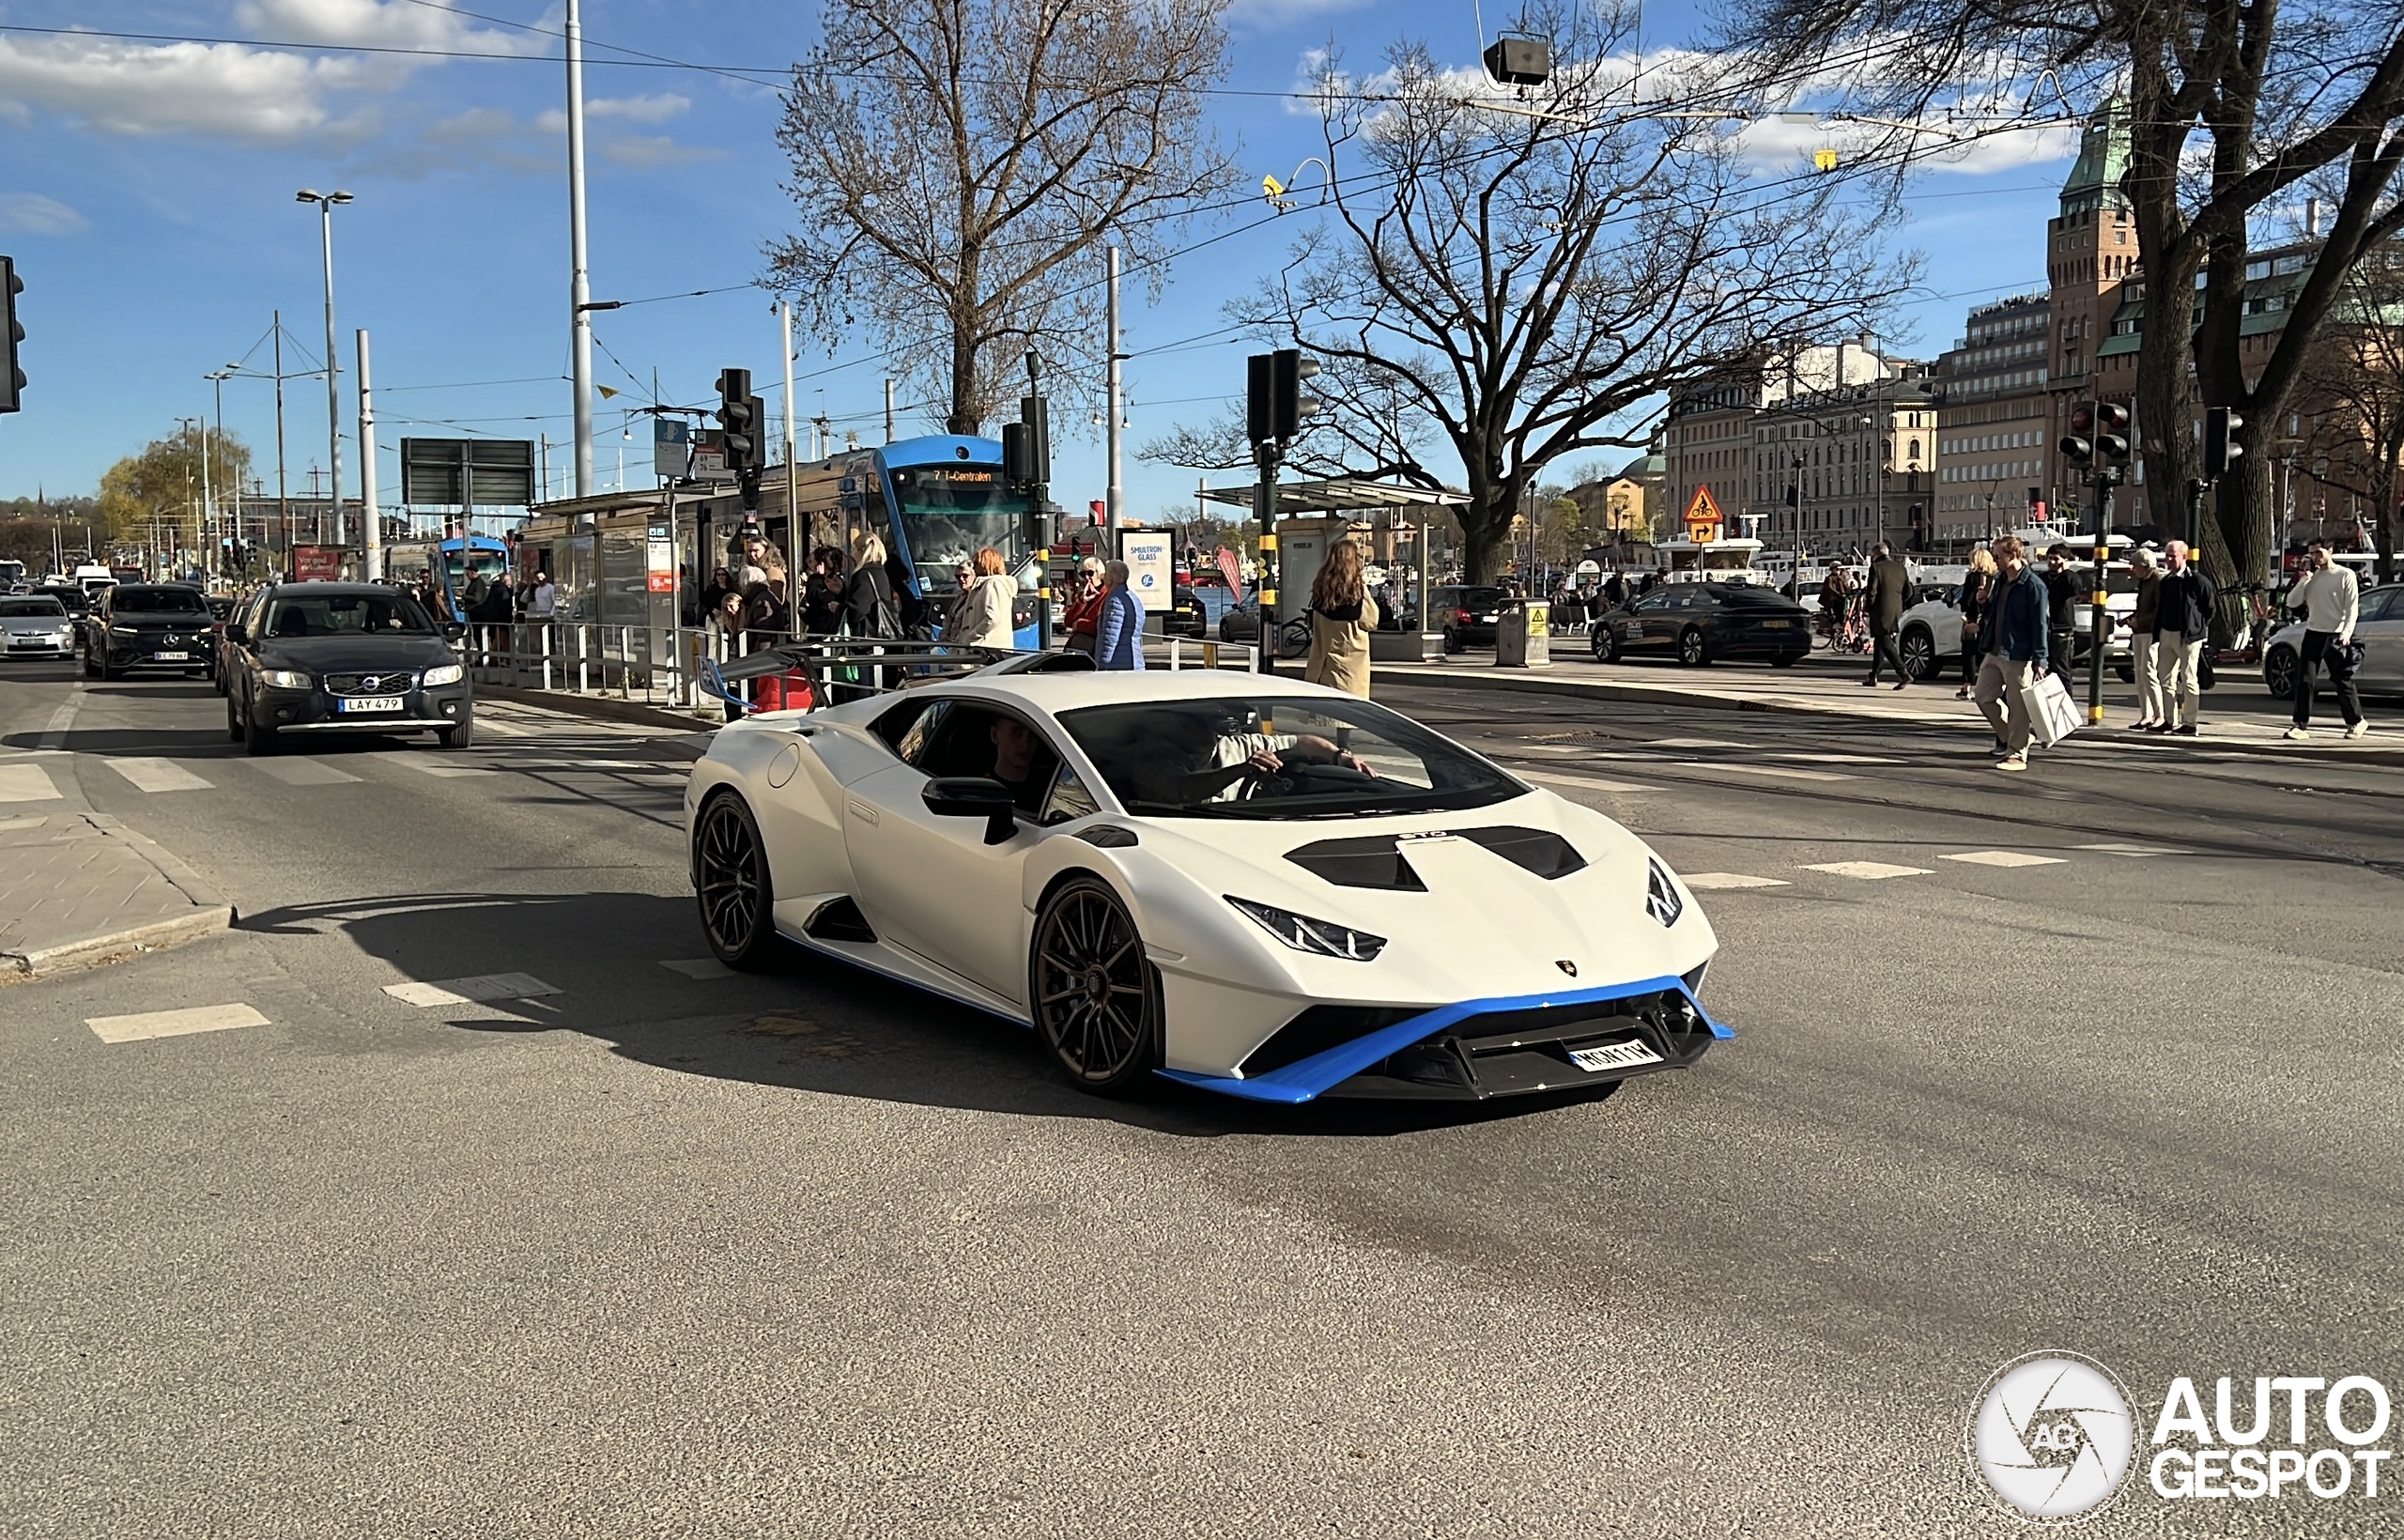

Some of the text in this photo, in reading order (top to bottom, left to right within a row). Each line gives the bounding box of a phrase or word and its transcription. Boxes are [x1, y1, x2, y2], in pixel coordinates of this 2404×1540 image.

[933, 470, 993, 482] 7 T-Centralen
[1137, 553, 1157, 562] GLASS
[348, 699, 398, 710] LAY 479
